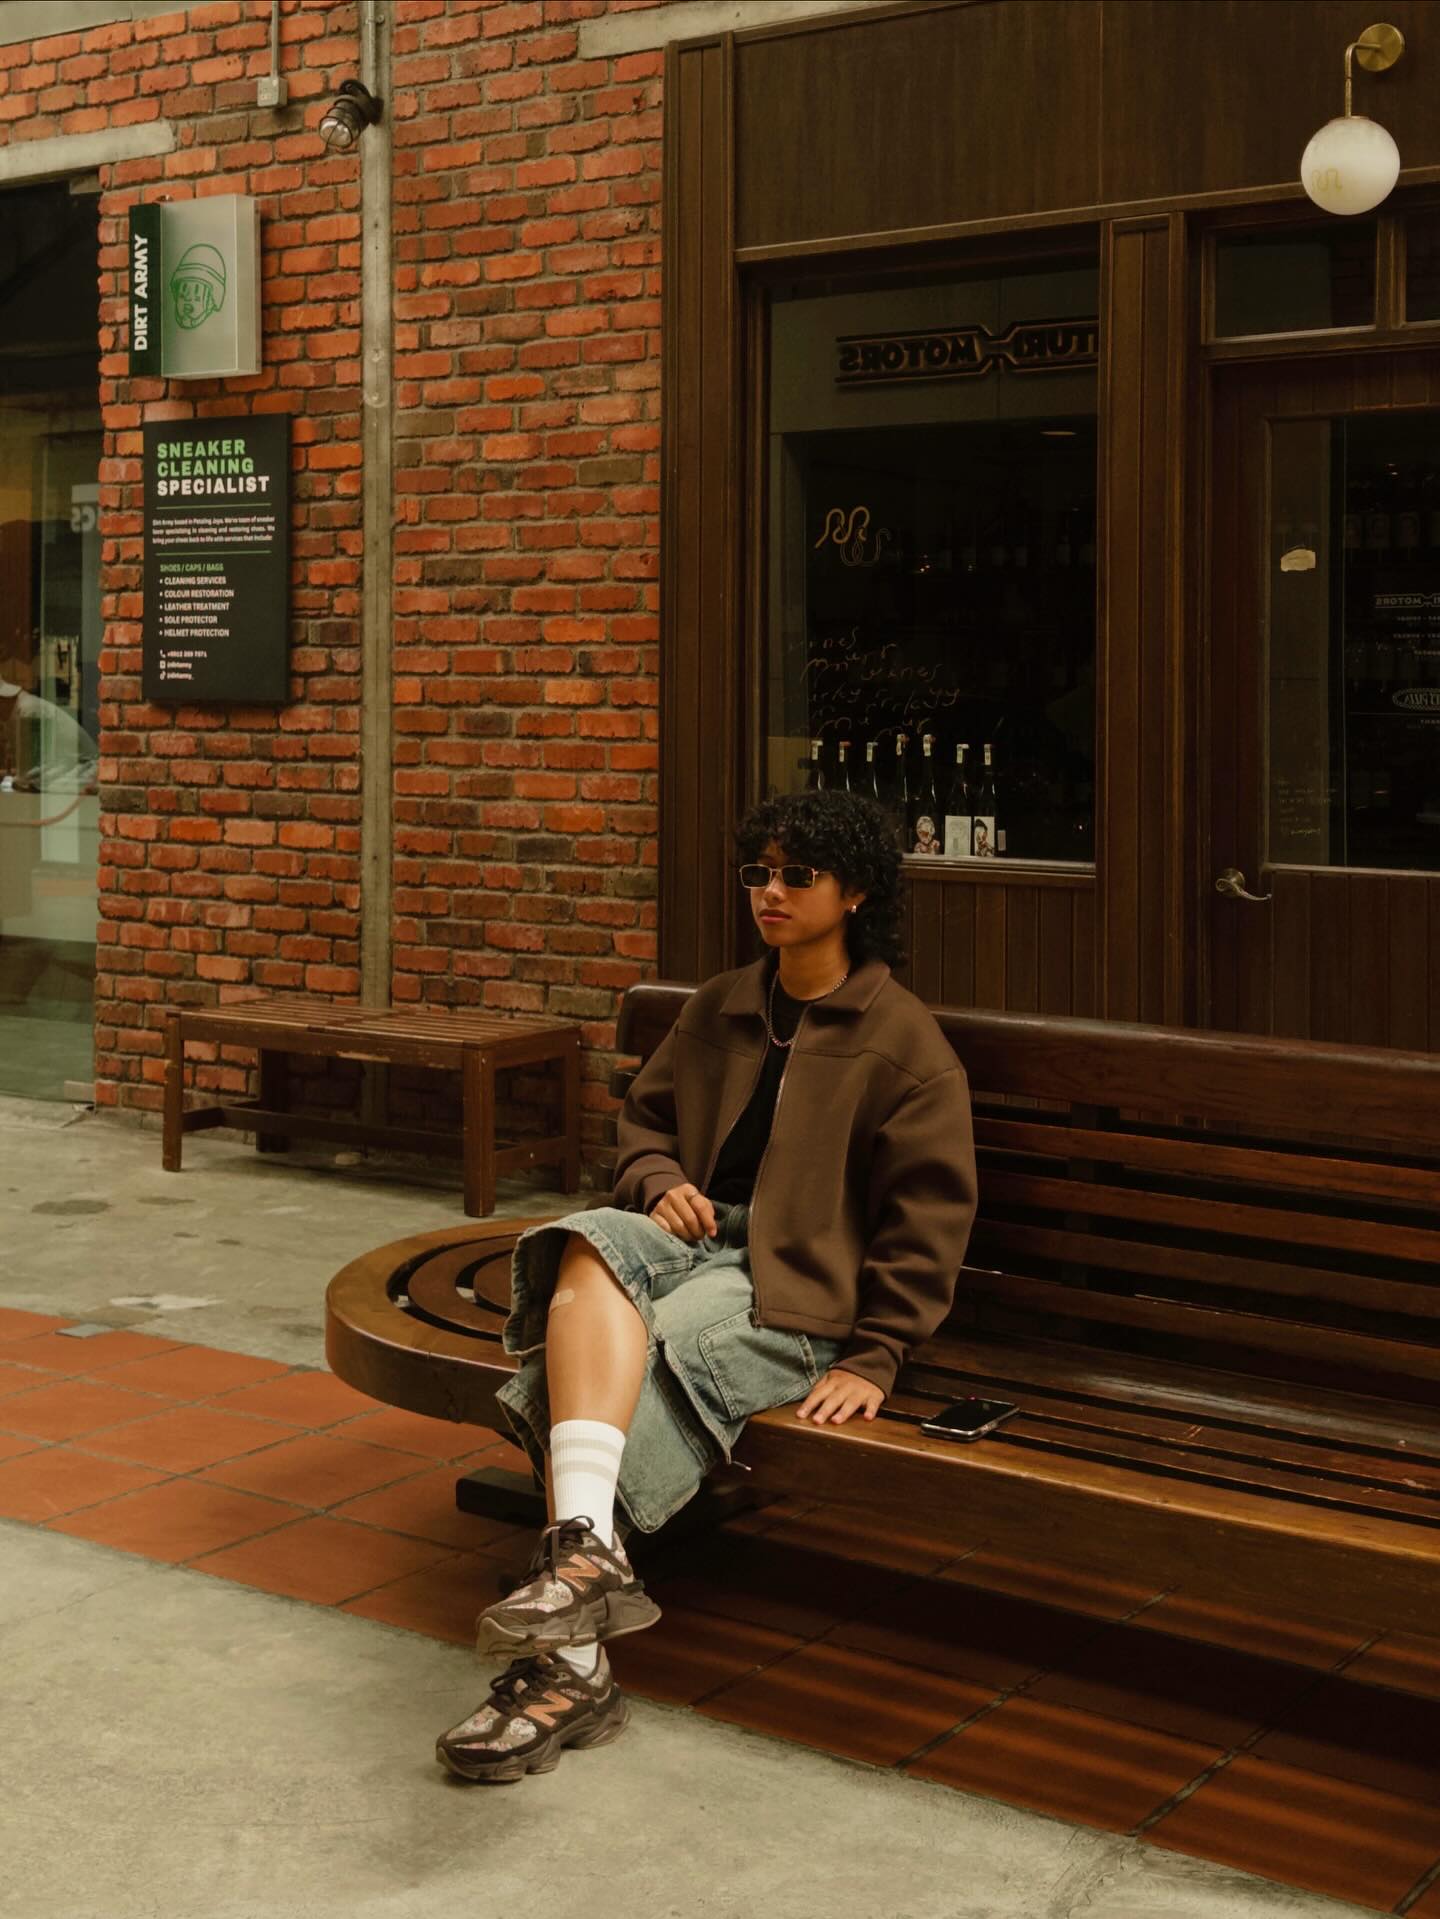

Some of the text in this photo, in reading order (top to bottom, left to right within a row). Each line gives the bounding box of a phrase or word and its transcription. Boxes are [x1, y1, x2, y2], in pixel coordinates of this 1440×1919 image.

[134, 234, 149, 351] DIRT ARMY
[157, 439, 246, 459] SNEAKER
[157, 458, 254, 477] CLEANING
[157, 476, 270, 497] SPECIALIST
[185, 563, 202, 572] CAPS
[164, 576, 227, 586] CLEANING SERVICES
[164, 589, 235, 599] COLOUR RESTORATION
[164, 602, 230, 611] LEATHER TREATMENT
[164, 615, 218, 624] SOLE PROTECTOR
[163, 628, 230, 638] HELMET PROTECTION
